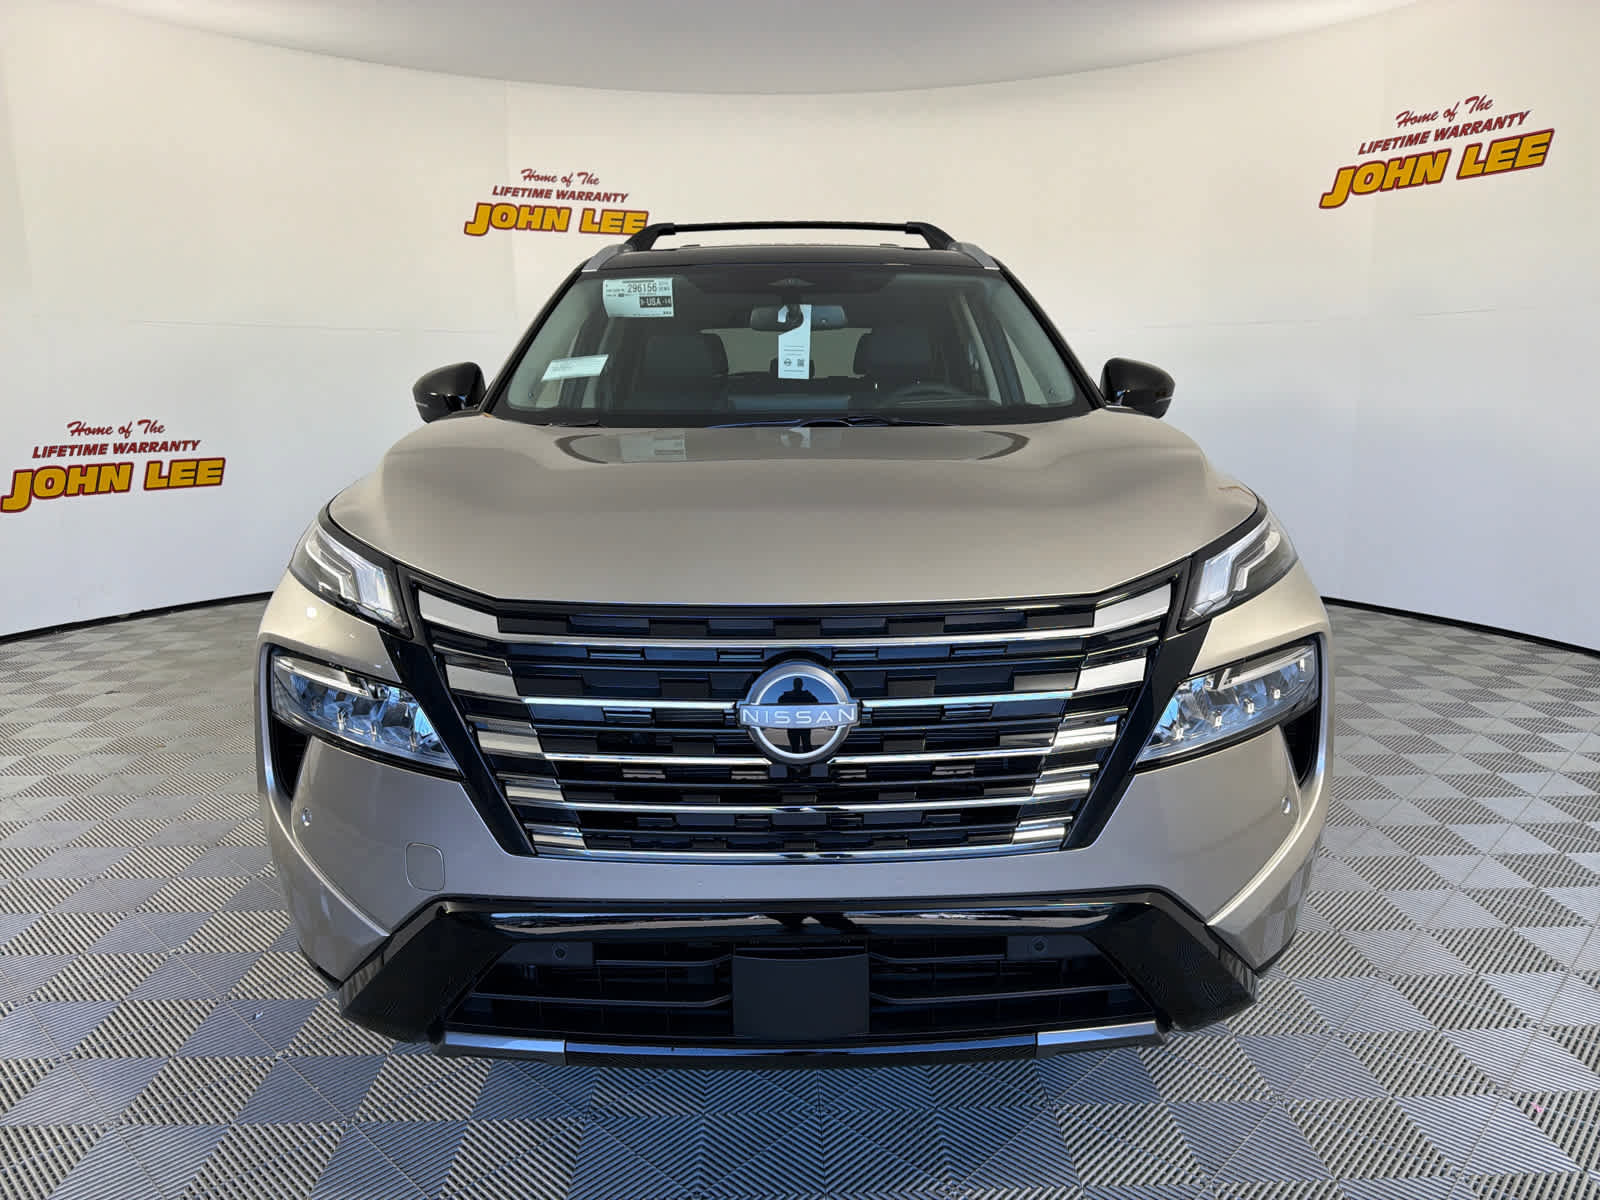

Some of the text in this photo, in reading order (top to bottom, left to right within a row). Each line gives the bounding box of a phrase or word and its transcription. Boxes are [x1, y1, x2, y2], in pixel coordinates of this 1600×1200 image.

[1395, 94, 1494, 128] Home of The
[1357, 110, 1532, 155] LIFETIME WARRANTY
[520, 168, 600, 187] Home of The
[1319, 128, 1555, 209] JOHN LEE
[492, 185, 629, 203] LIFETIME WARRANTY
[464, 203, 649, 236] JOHN LEE
[67, 419, 166, 438] Home of The
[32, 439, 201, 459] LIFETIME WARRANTY
[0, 456, 226, 513] JOHN LEE
[742, 708, 855, 724] NISSAN
